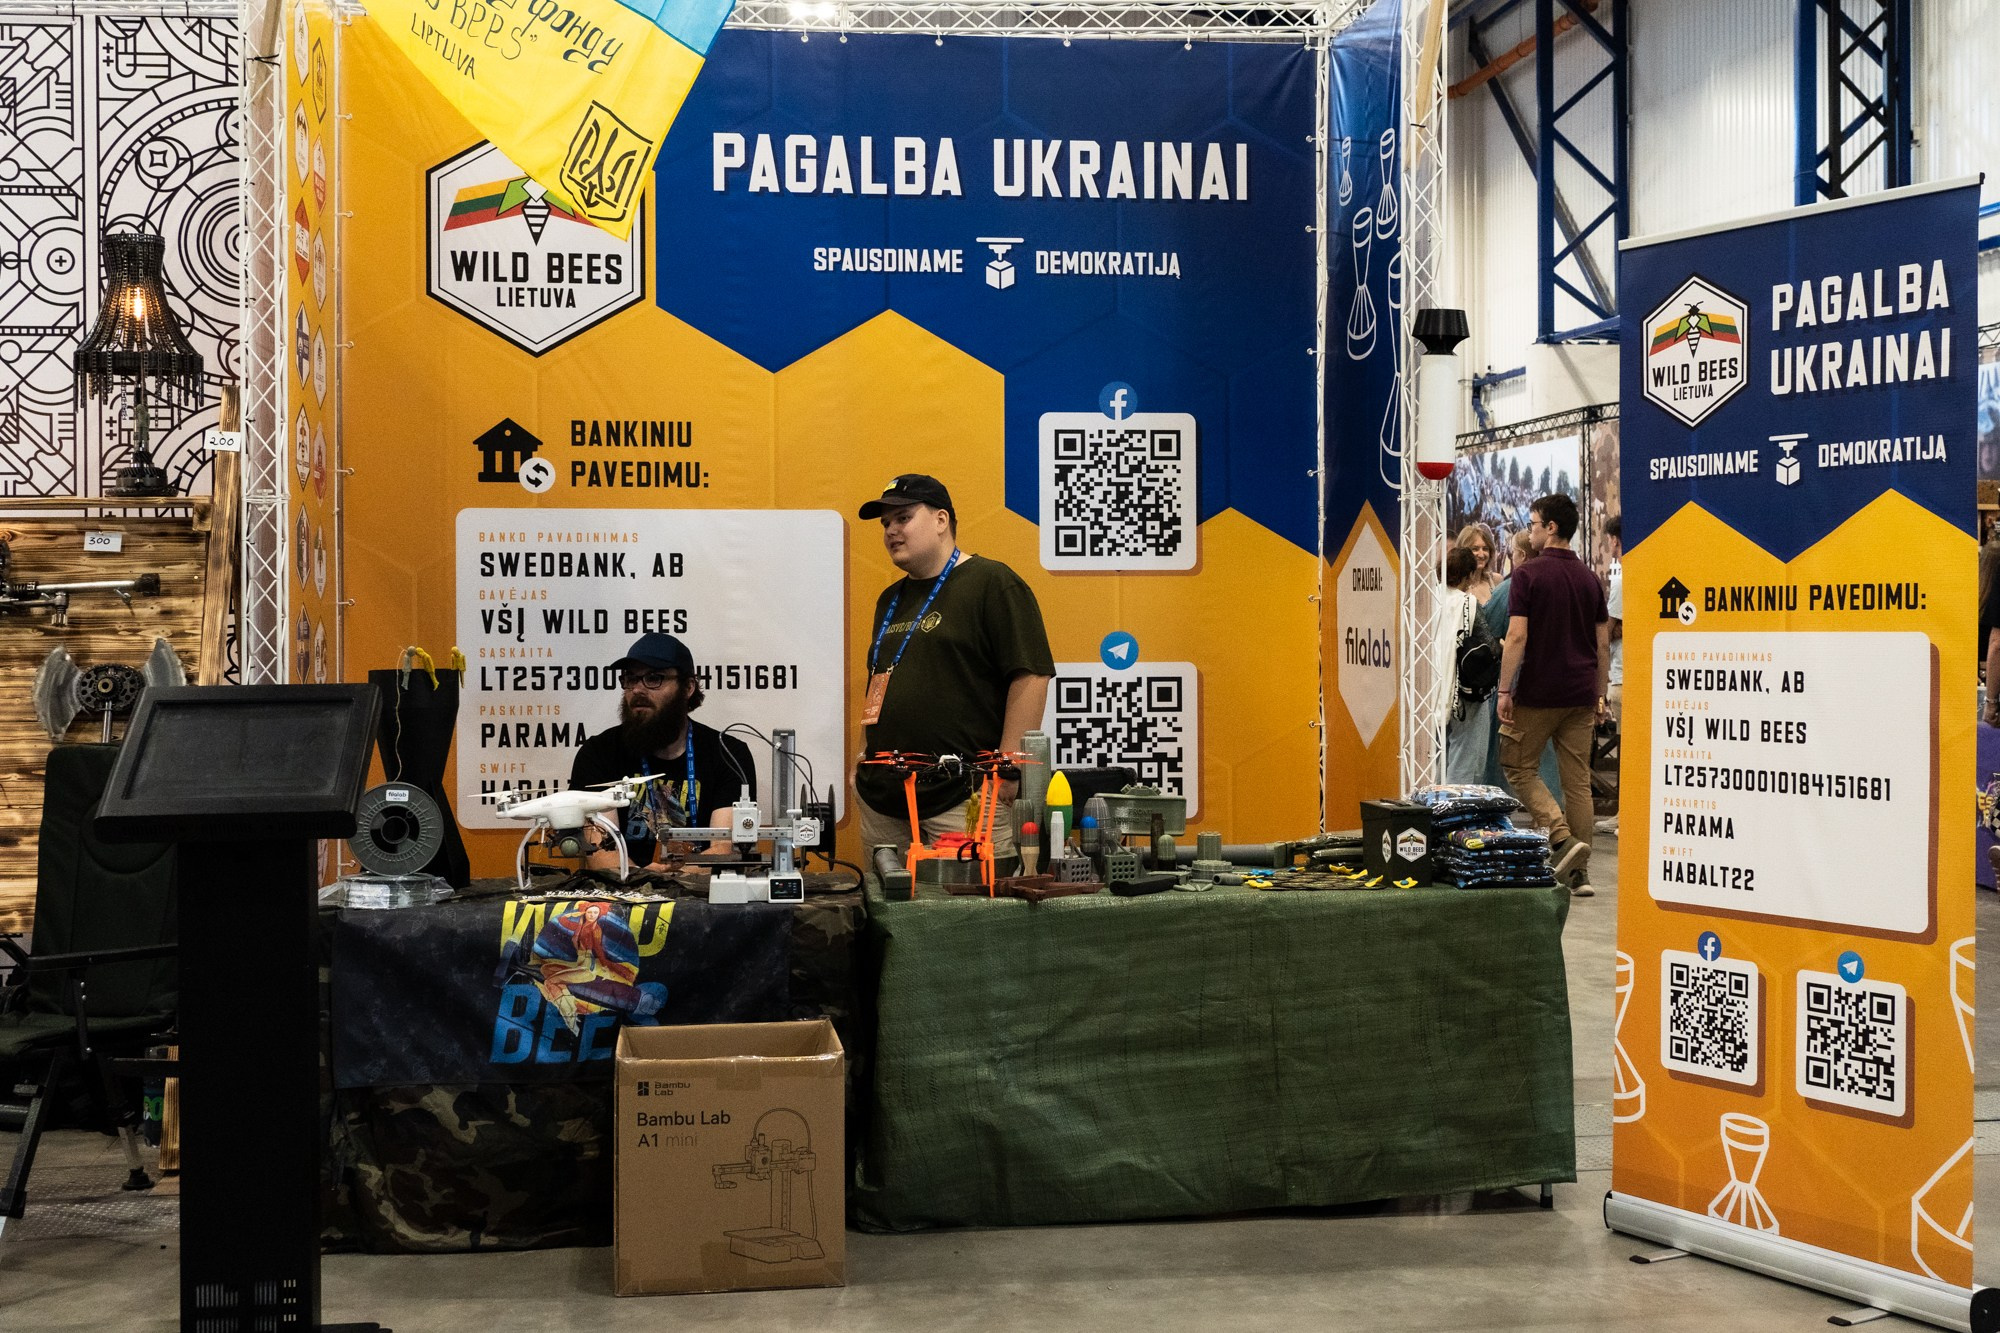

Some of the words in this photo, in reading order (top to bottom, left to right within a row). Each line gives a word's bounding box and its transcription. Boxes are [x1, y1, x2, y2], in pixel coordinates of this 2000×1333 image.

[713, 132, 962, 196] PAGALBA
[992, 138, 1248, 200] UKRAINAI
[450, 250, 529, 282] WILD
[547, 252, 622, 284] BEES
[813, 247, 963, 273] SPAUSDINAME
[1035, 250, 1181, 279] DEMOKRATIJĄ
[496, 287, 576, 308] LIETUVA
[1772, 259, 1949, 331] PAGALBA
[1652, 363, 1690, 388] WILD
[1698, 357, 1739, 382] BEES
[1770, 328, 1951, 396] UKRAINAI
[1673, 386, 1714, 401] LIETUVA
[210, 437, 234, 446] 200
[570, 420, 692, 447] BANKINIU
[1650, 449, 1758, 480] SPAUSDINAME
[1818, 434, 1947, 468] DEMOKRATIJĄ
[570, 460, 709, 488] PAVEDIMU:
[88, 536, 111, 545] 300
[479, 531, 526, 543] BANKO
[537, 531, 639, 543] PAVADINIMAS
[480, 552, 636, 579] SWEDBANK,
[652, 552, 684, 578] AB
[1352, 567, 1383, 592] DRAUGAI:
[479, 586, 547, 600] GAVĖJAS
[1704, 585, 1798, 613] BANKINIU
[1809, 582, 1927, 611] PAVEDIMU:
[481, 603, 526, 643] VŠĮ
[542, 608, 609, 634] WILD
[624, 608, 688, 634] BEES
[1345, 627, 1391, 669] filalab
[1665, 652, 1696, 661] BANKO
[1703, 652, 1773, 662] PAVADINIMAS
[1666, 668, 1770, 694] SWEDBANK,
[1781, 670, 1805, 693] AB
[479, 705, 560, 716] PASKIRTIS
[481, 722, 587, 748] PARAMA
[1666, 711, 1694, 746] VŠĮ
[1705, 718, 1750, 741] WILD
[1760, 720, 1807, 744] BEES
[479, 763, 527, 774] SWIFT
[1664, 764, 1891, 801] LT257300010184151681
[1663, 797, 1717, 810] PASKIRTIS
[1664, 812, 1735, 840] PARAMA
[1662, 846, 1694, 857] SWIFT
[1662, 860, 1755, 891] HABALT22
[654, 1081, 691, 1089] Bambu
[637, 1110, 695, 1127] Bambu
[700, 1109, 731, 1125] Lab
[637, 1132, 658, 1148] A1
[665, 1132, 698, 1147] mini
